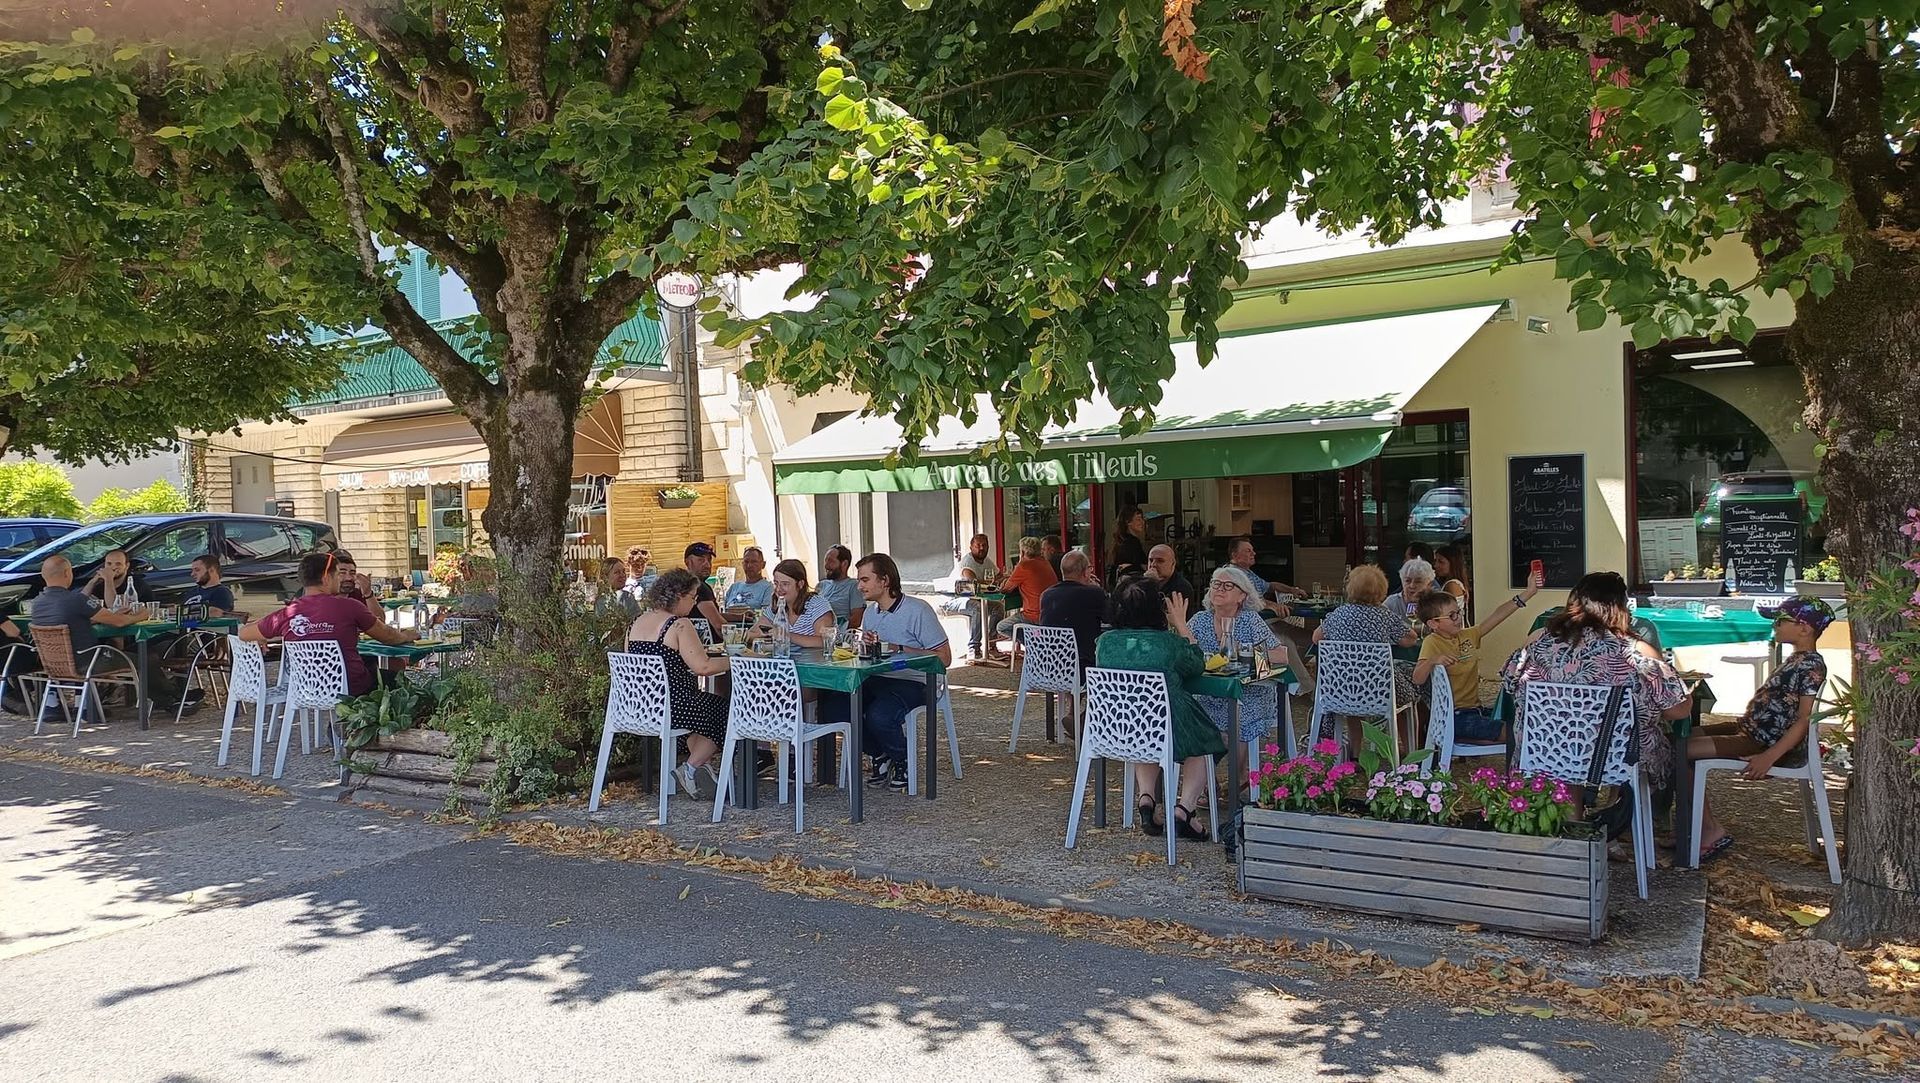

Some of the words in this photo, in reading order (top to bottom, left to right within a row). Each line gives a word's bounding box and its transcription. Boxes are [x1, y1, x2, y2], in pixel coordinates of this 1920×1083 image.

[338, 472, 363, 488] SALON
[924, 461, 957, 486] Au
[1019, 456, 1058, 482] des
[1068, 449, 1158, 480] Tilleuls
